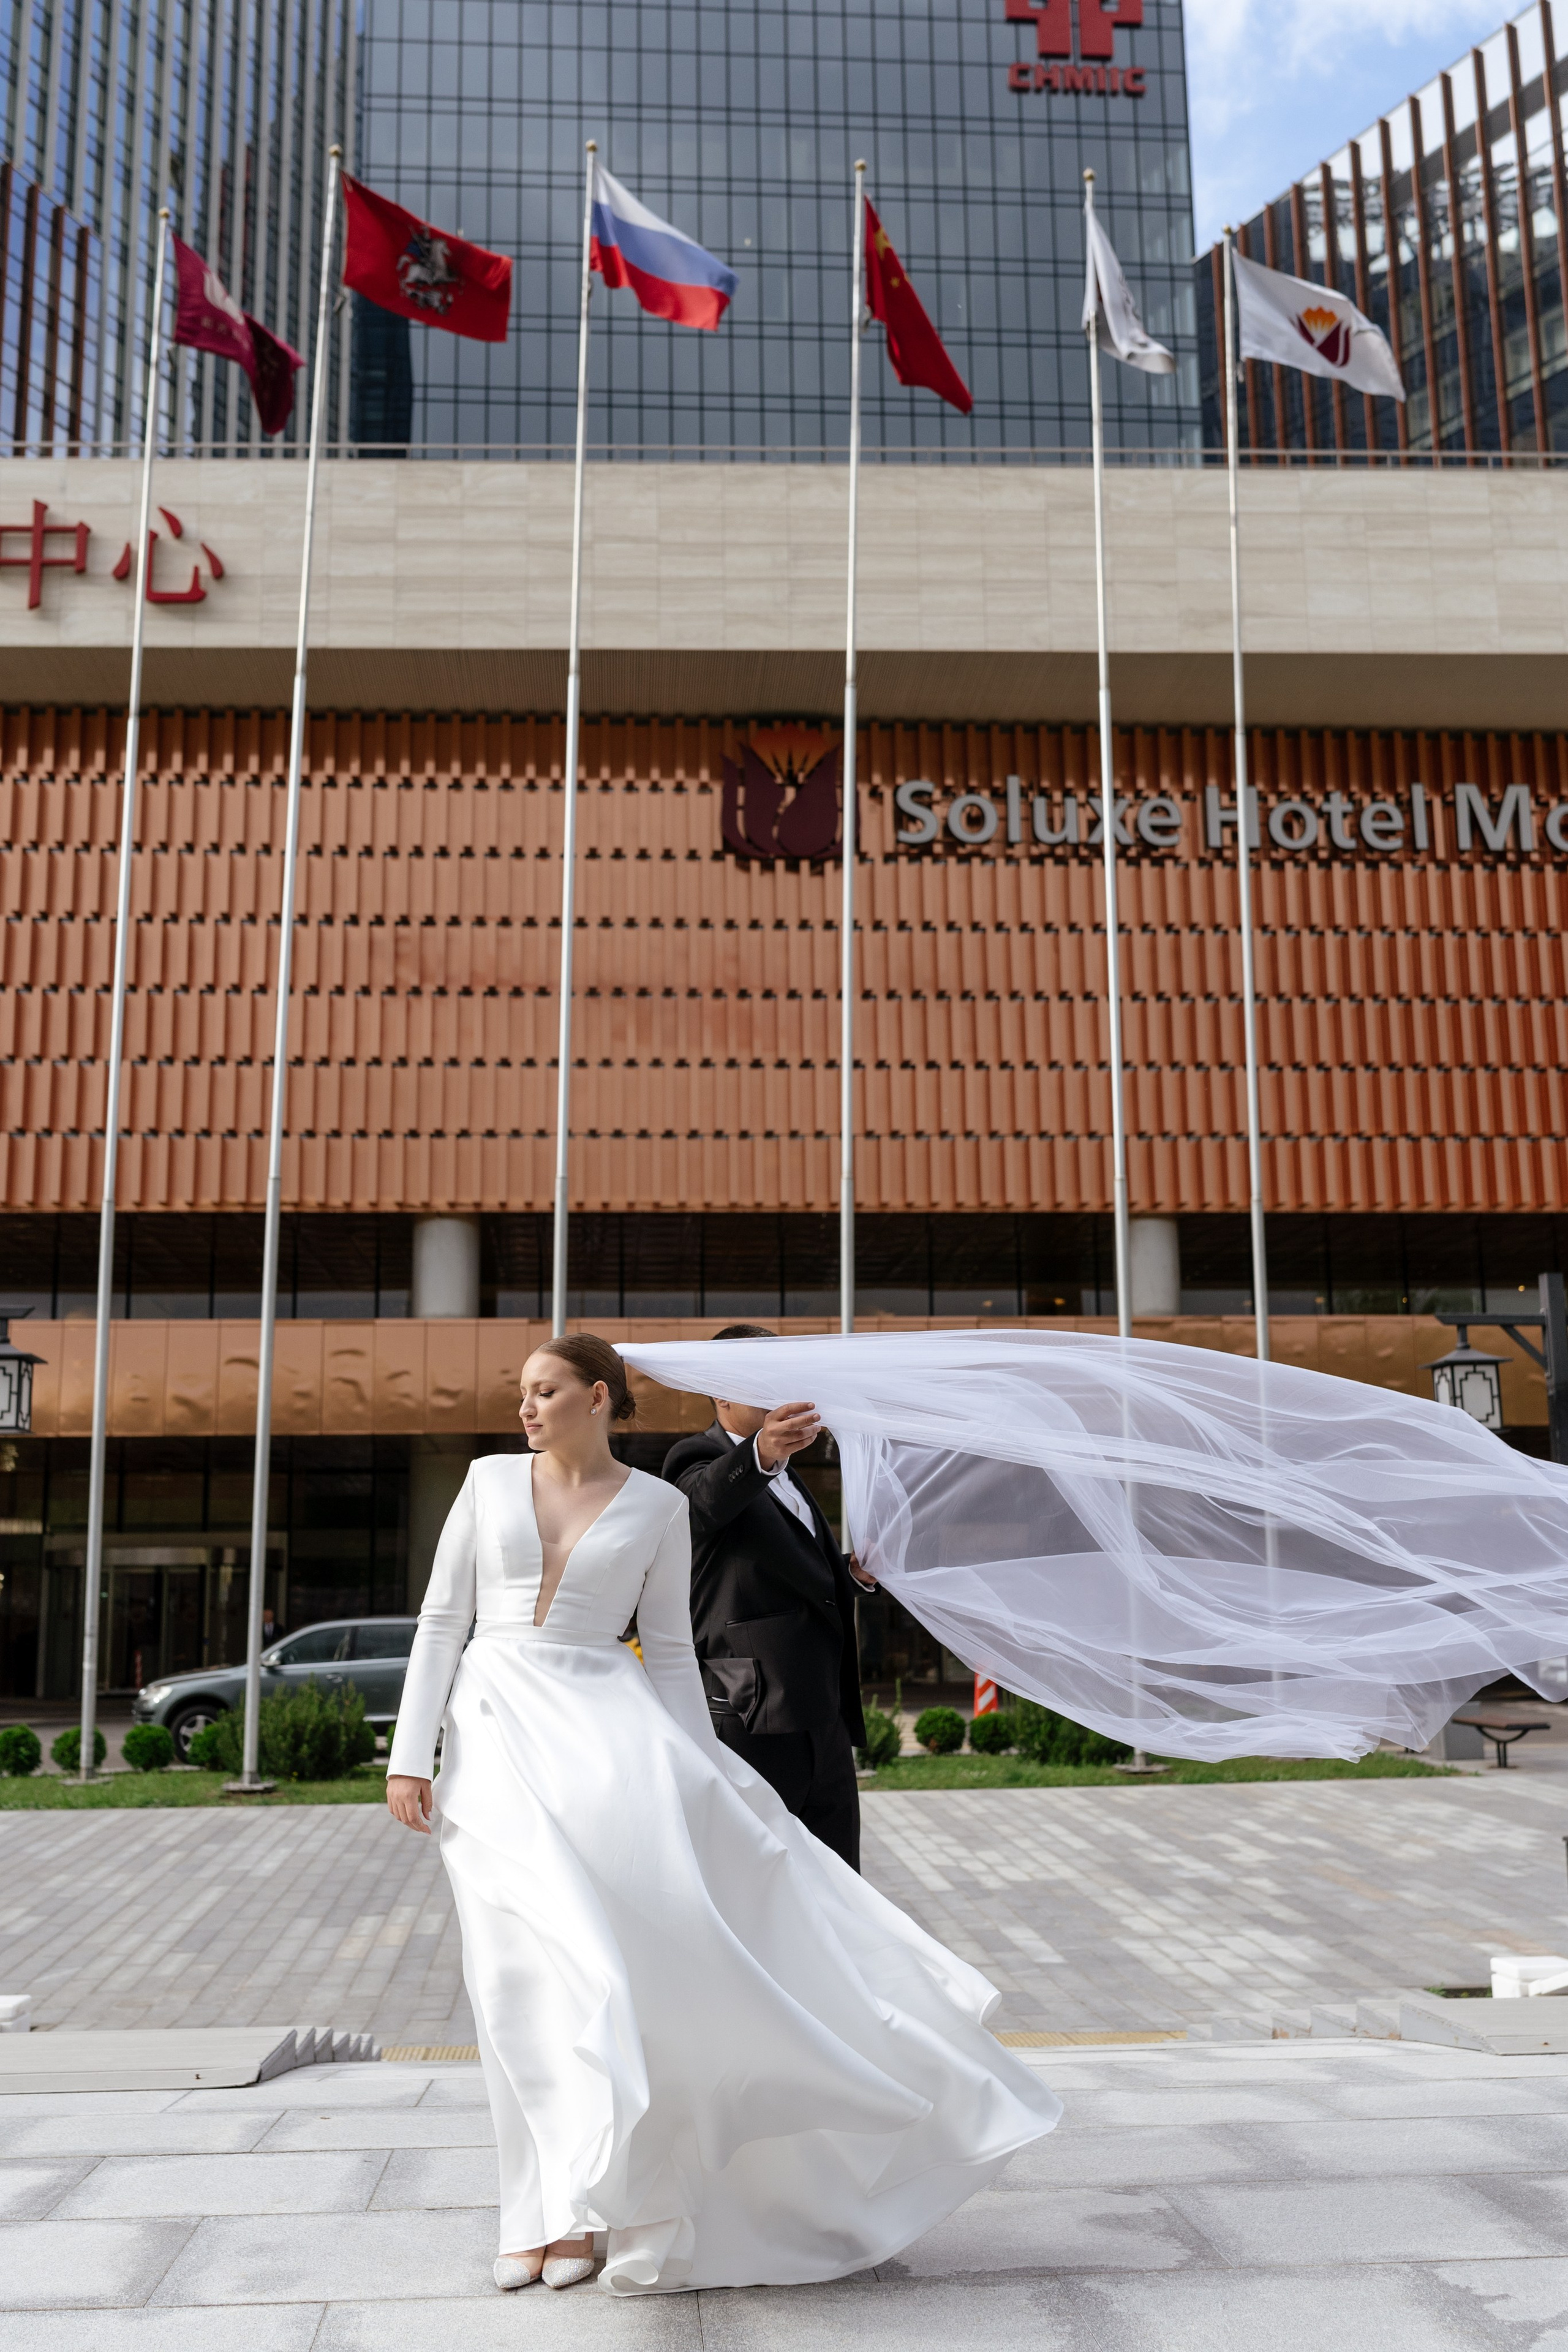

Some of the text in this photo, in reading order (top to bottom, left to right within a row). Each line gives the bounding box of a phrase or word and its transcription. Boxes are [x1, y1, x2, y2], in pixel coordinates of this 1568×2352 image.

[1008, 63, 1146, 96] CHMIIC
[0, 499, 225, 609] 中心
[896, 775, 1182, 846] Soluxe
[1205, 783, 1428, 851] Hotel
